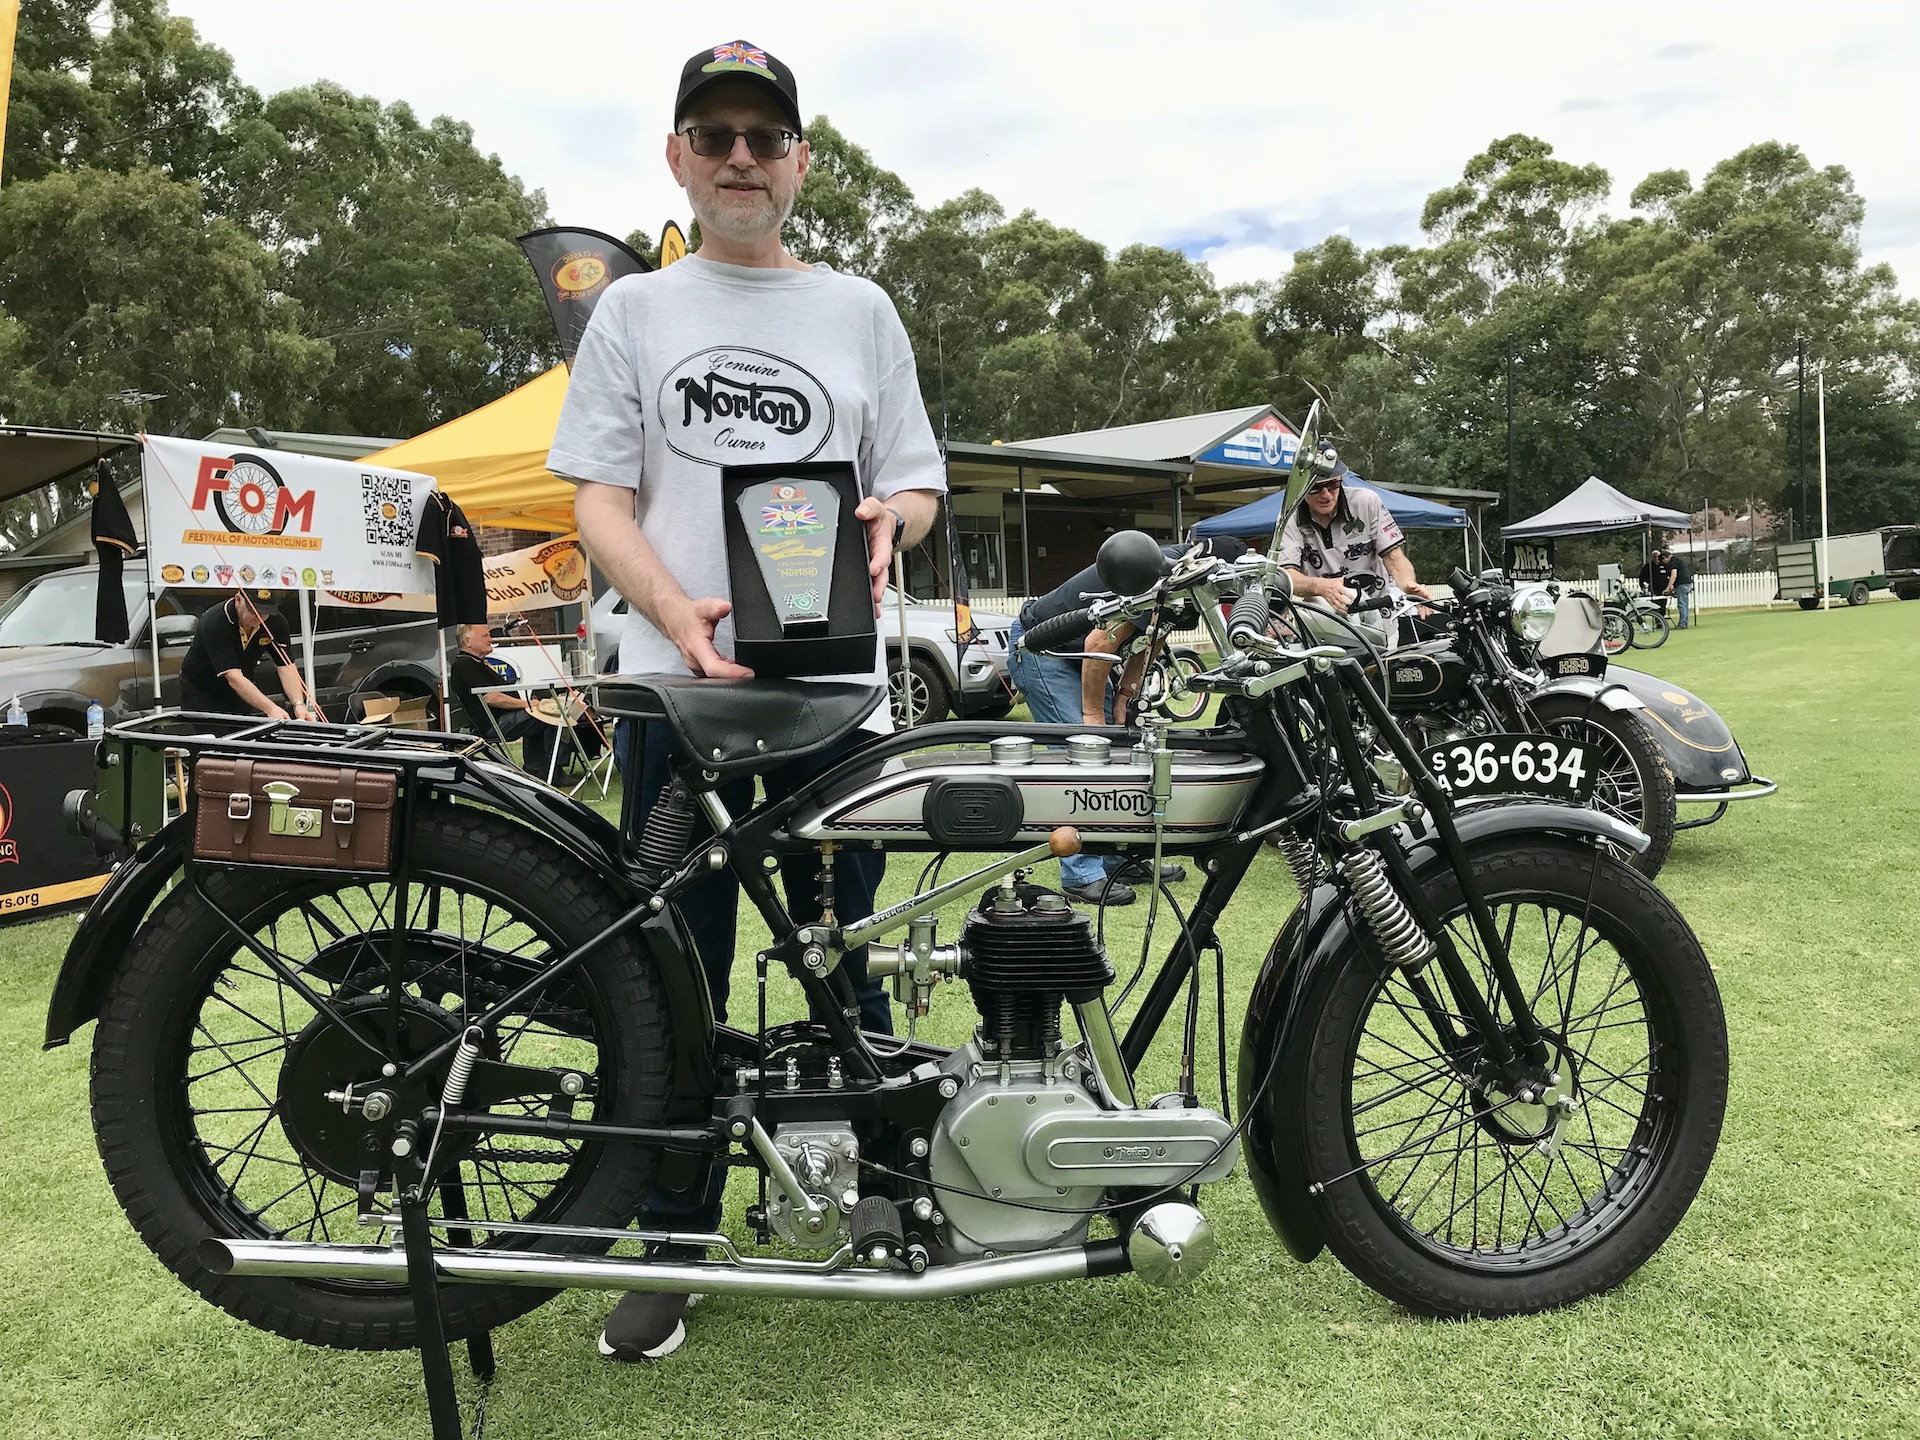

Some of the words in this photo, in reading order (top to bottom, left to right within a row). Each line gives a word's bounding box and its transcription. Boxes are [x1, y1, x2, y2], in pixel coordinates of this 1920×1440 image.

[708, 353, 780, 377] Genuine
[675, 371, 811, 435] Norton
[714, 427, 766, 450] Owner
[1246, 434, 1261, 443] Home
[191, 455, 316, 533] FOM
[188, 532, 228, 543] FESTIVAL
[230, 535, 241, 544] OF
[243, 535, 308, 548] MOTORCYCLING
[309, 540, 318, 548] SA
[542, 541, 575, 558] CLASSIC
[380, 550, 394, 558] SCAN
[395, 551, 403, 559] ME
[776, 566, 818, 579] Norton
[485, 585, 525, 601] Club
[522, 580, 548, 594] Inc
[1534, 597, 1546, 607] 28
[1450, 741, 1586, 789] 36-634
[1064, 788, 1155, 817] Norton
